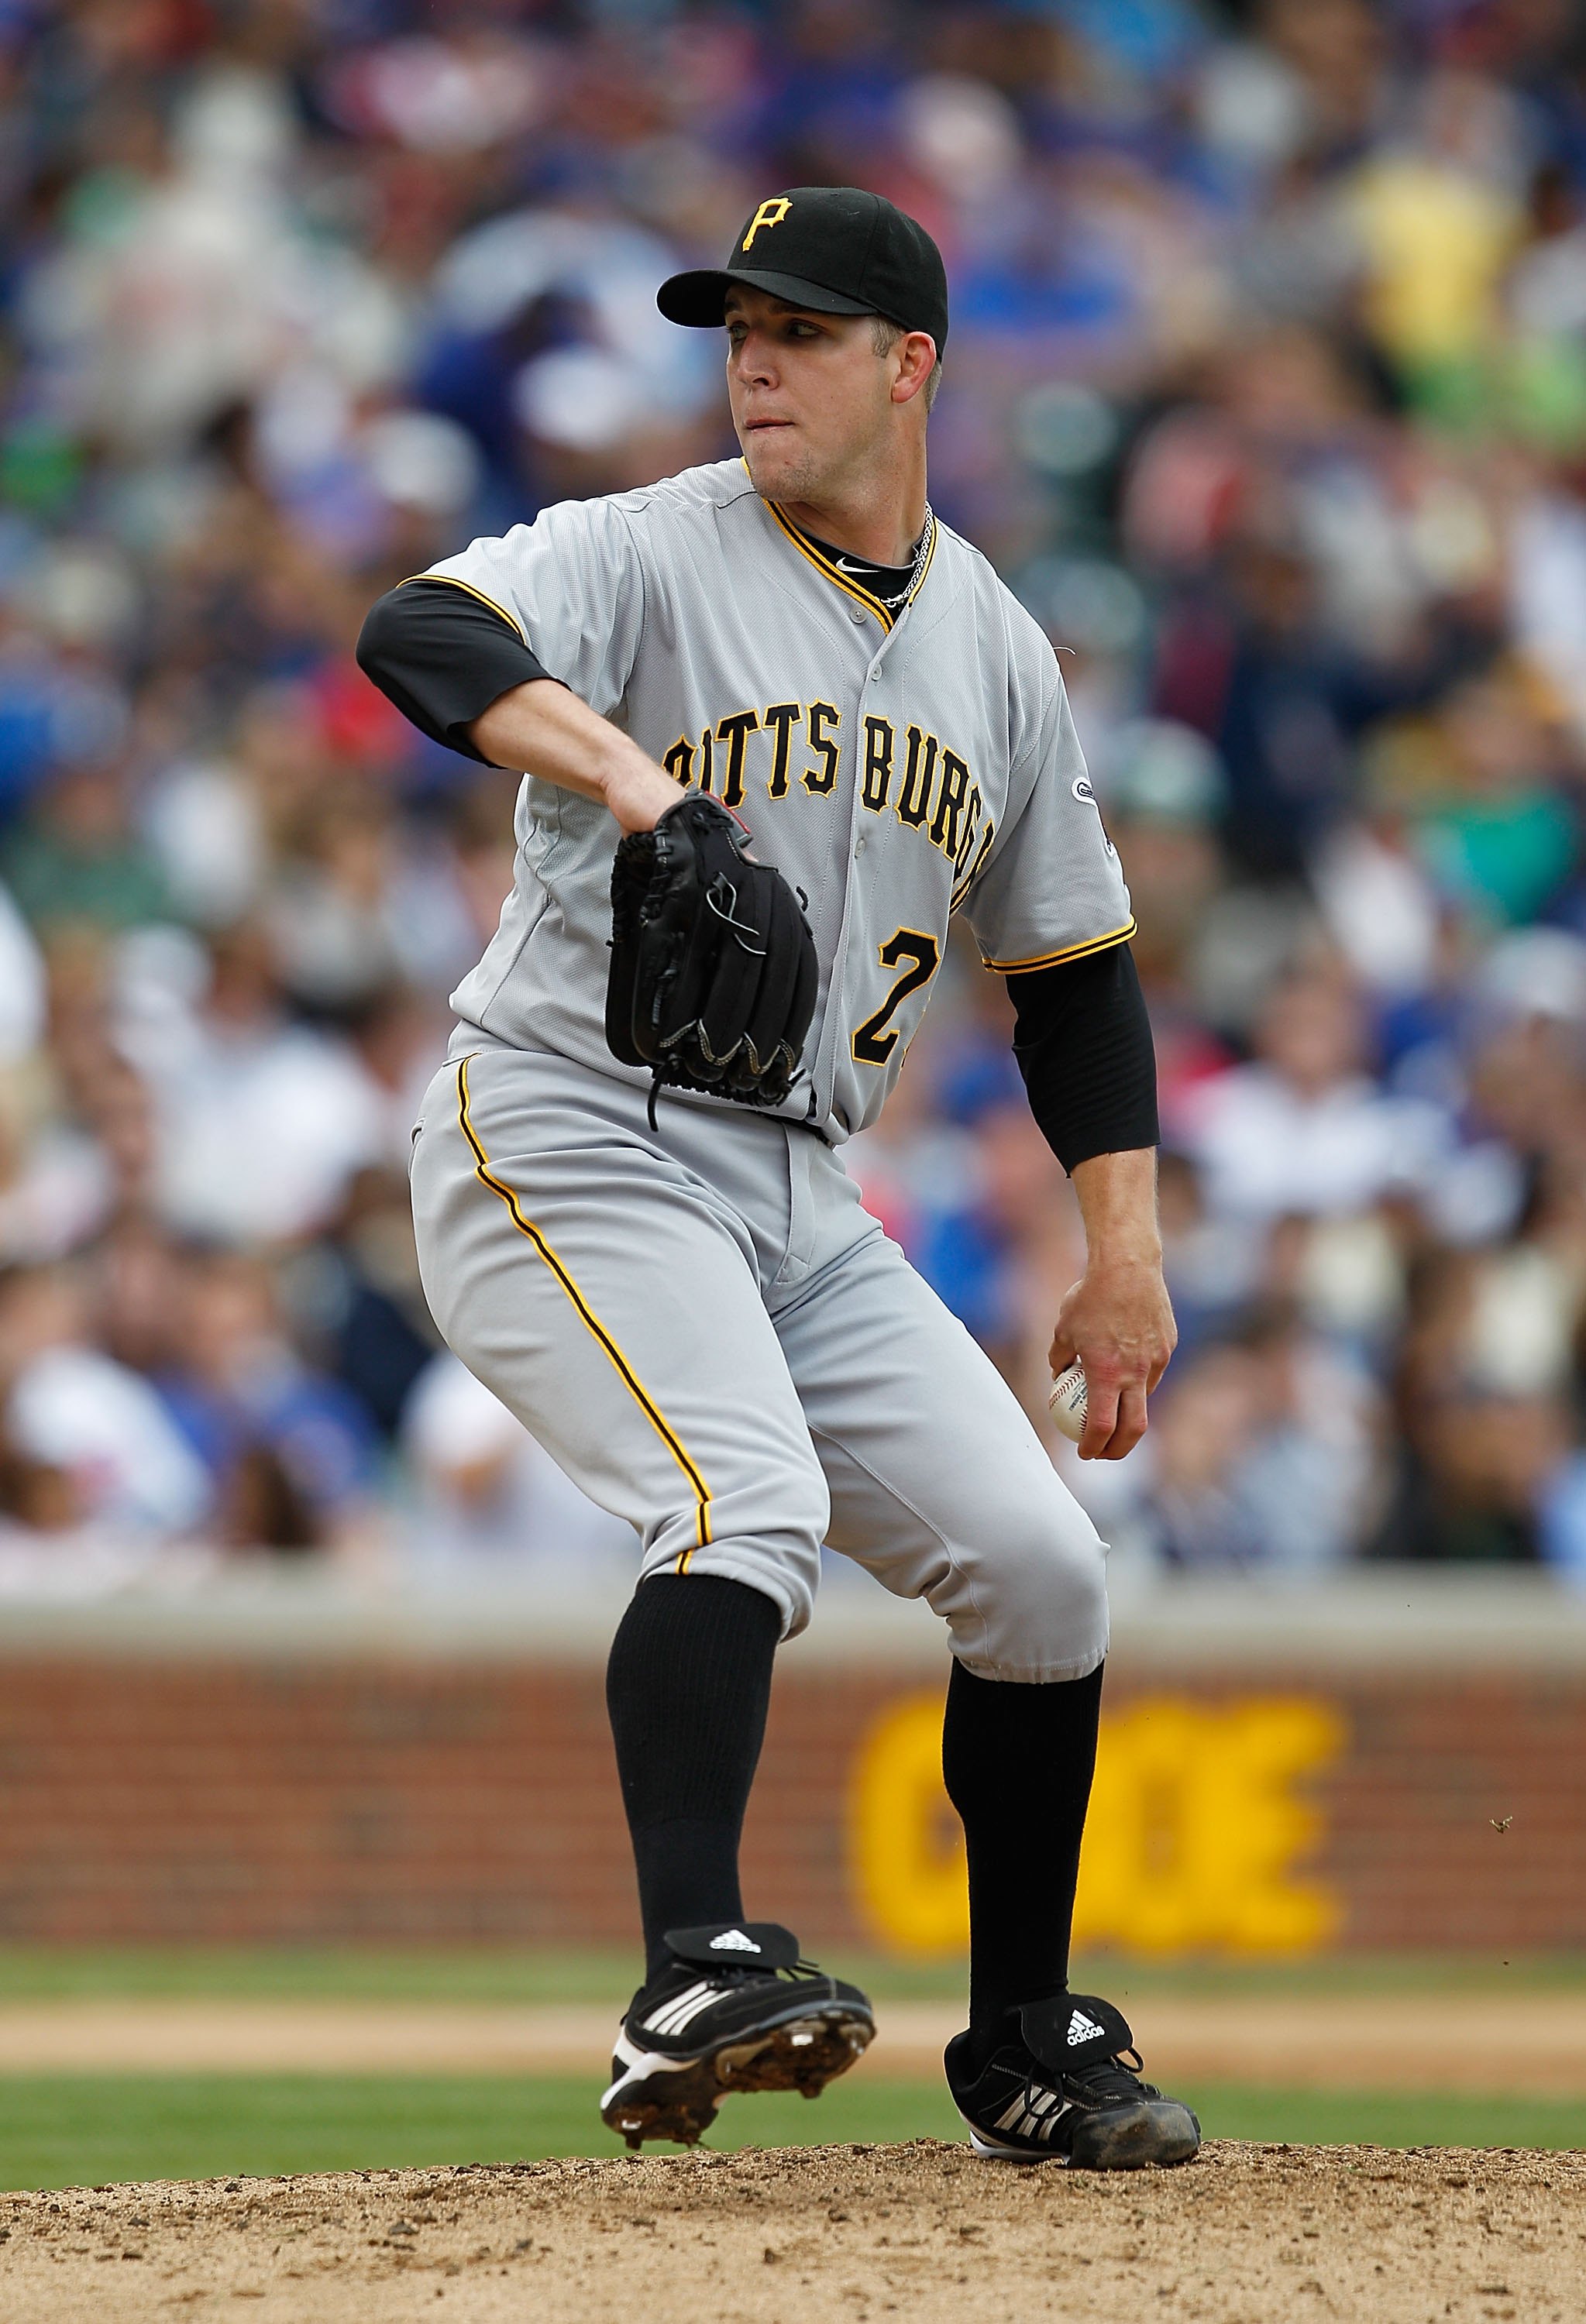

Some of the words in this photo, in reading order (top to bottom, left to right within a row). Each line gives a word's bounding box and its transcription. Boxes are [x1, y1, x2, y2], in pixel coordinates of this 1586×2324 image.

[742, 197, 793, 253] P
[851, 926, 941, 1069] 2
[853, 1697, 1340, 1957] COE
[1067, 2025, 1105, 2047] adidas
